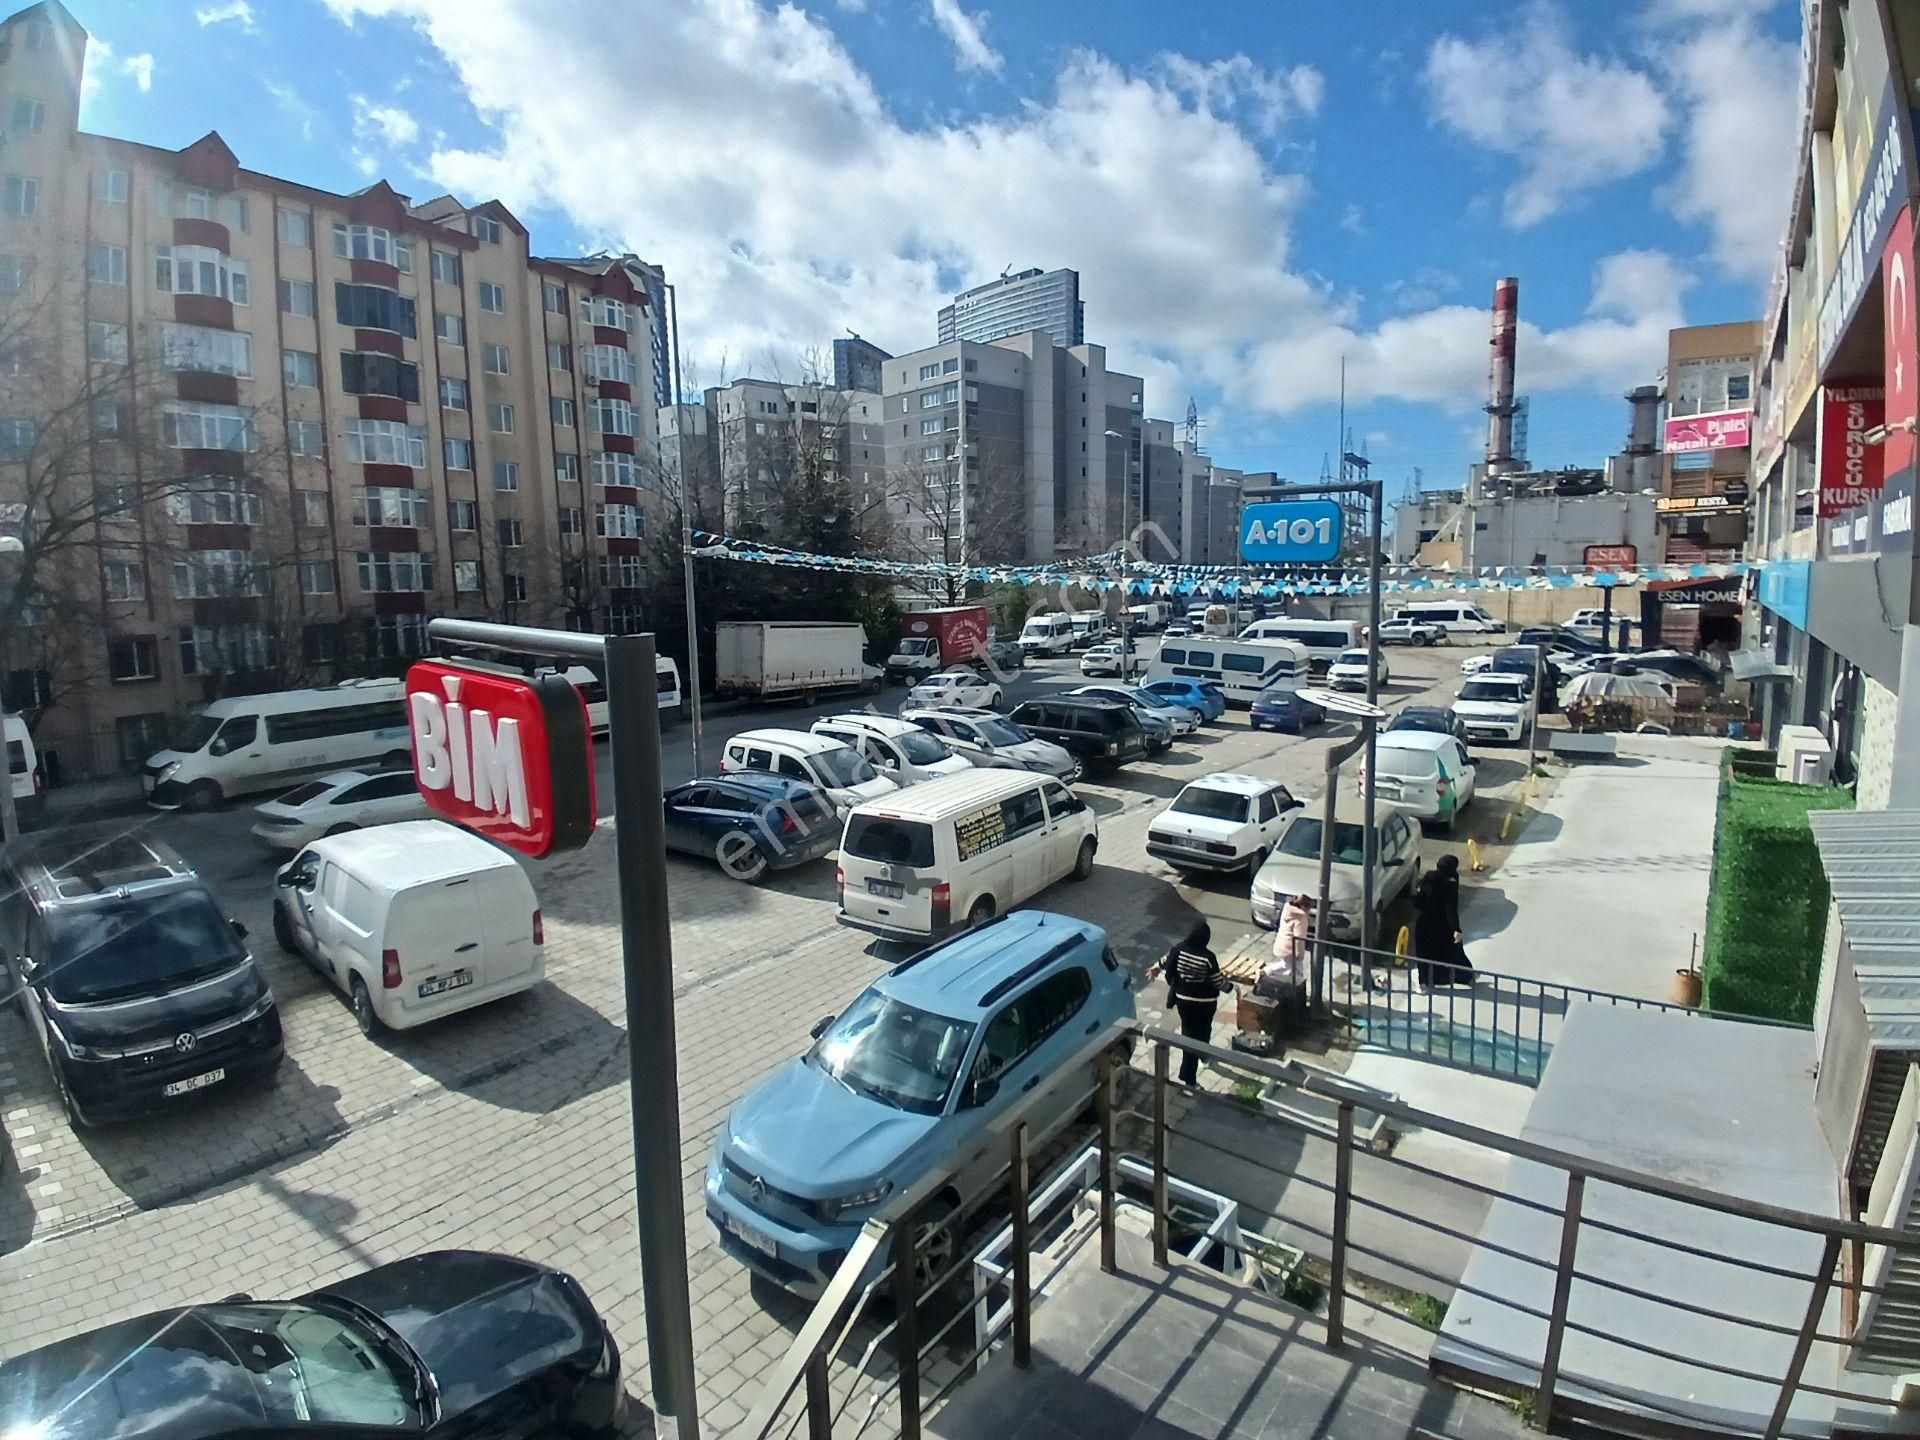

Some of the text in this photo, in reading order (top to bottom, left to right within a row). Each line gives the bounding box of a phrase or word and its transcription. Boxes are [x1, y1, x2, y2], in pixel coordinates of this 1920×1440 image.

[1659, 590, 1740, 602] ESEN HOME
[168, 1085, 179, 1094] 34
[204, 1071, 221, 1083] 037
